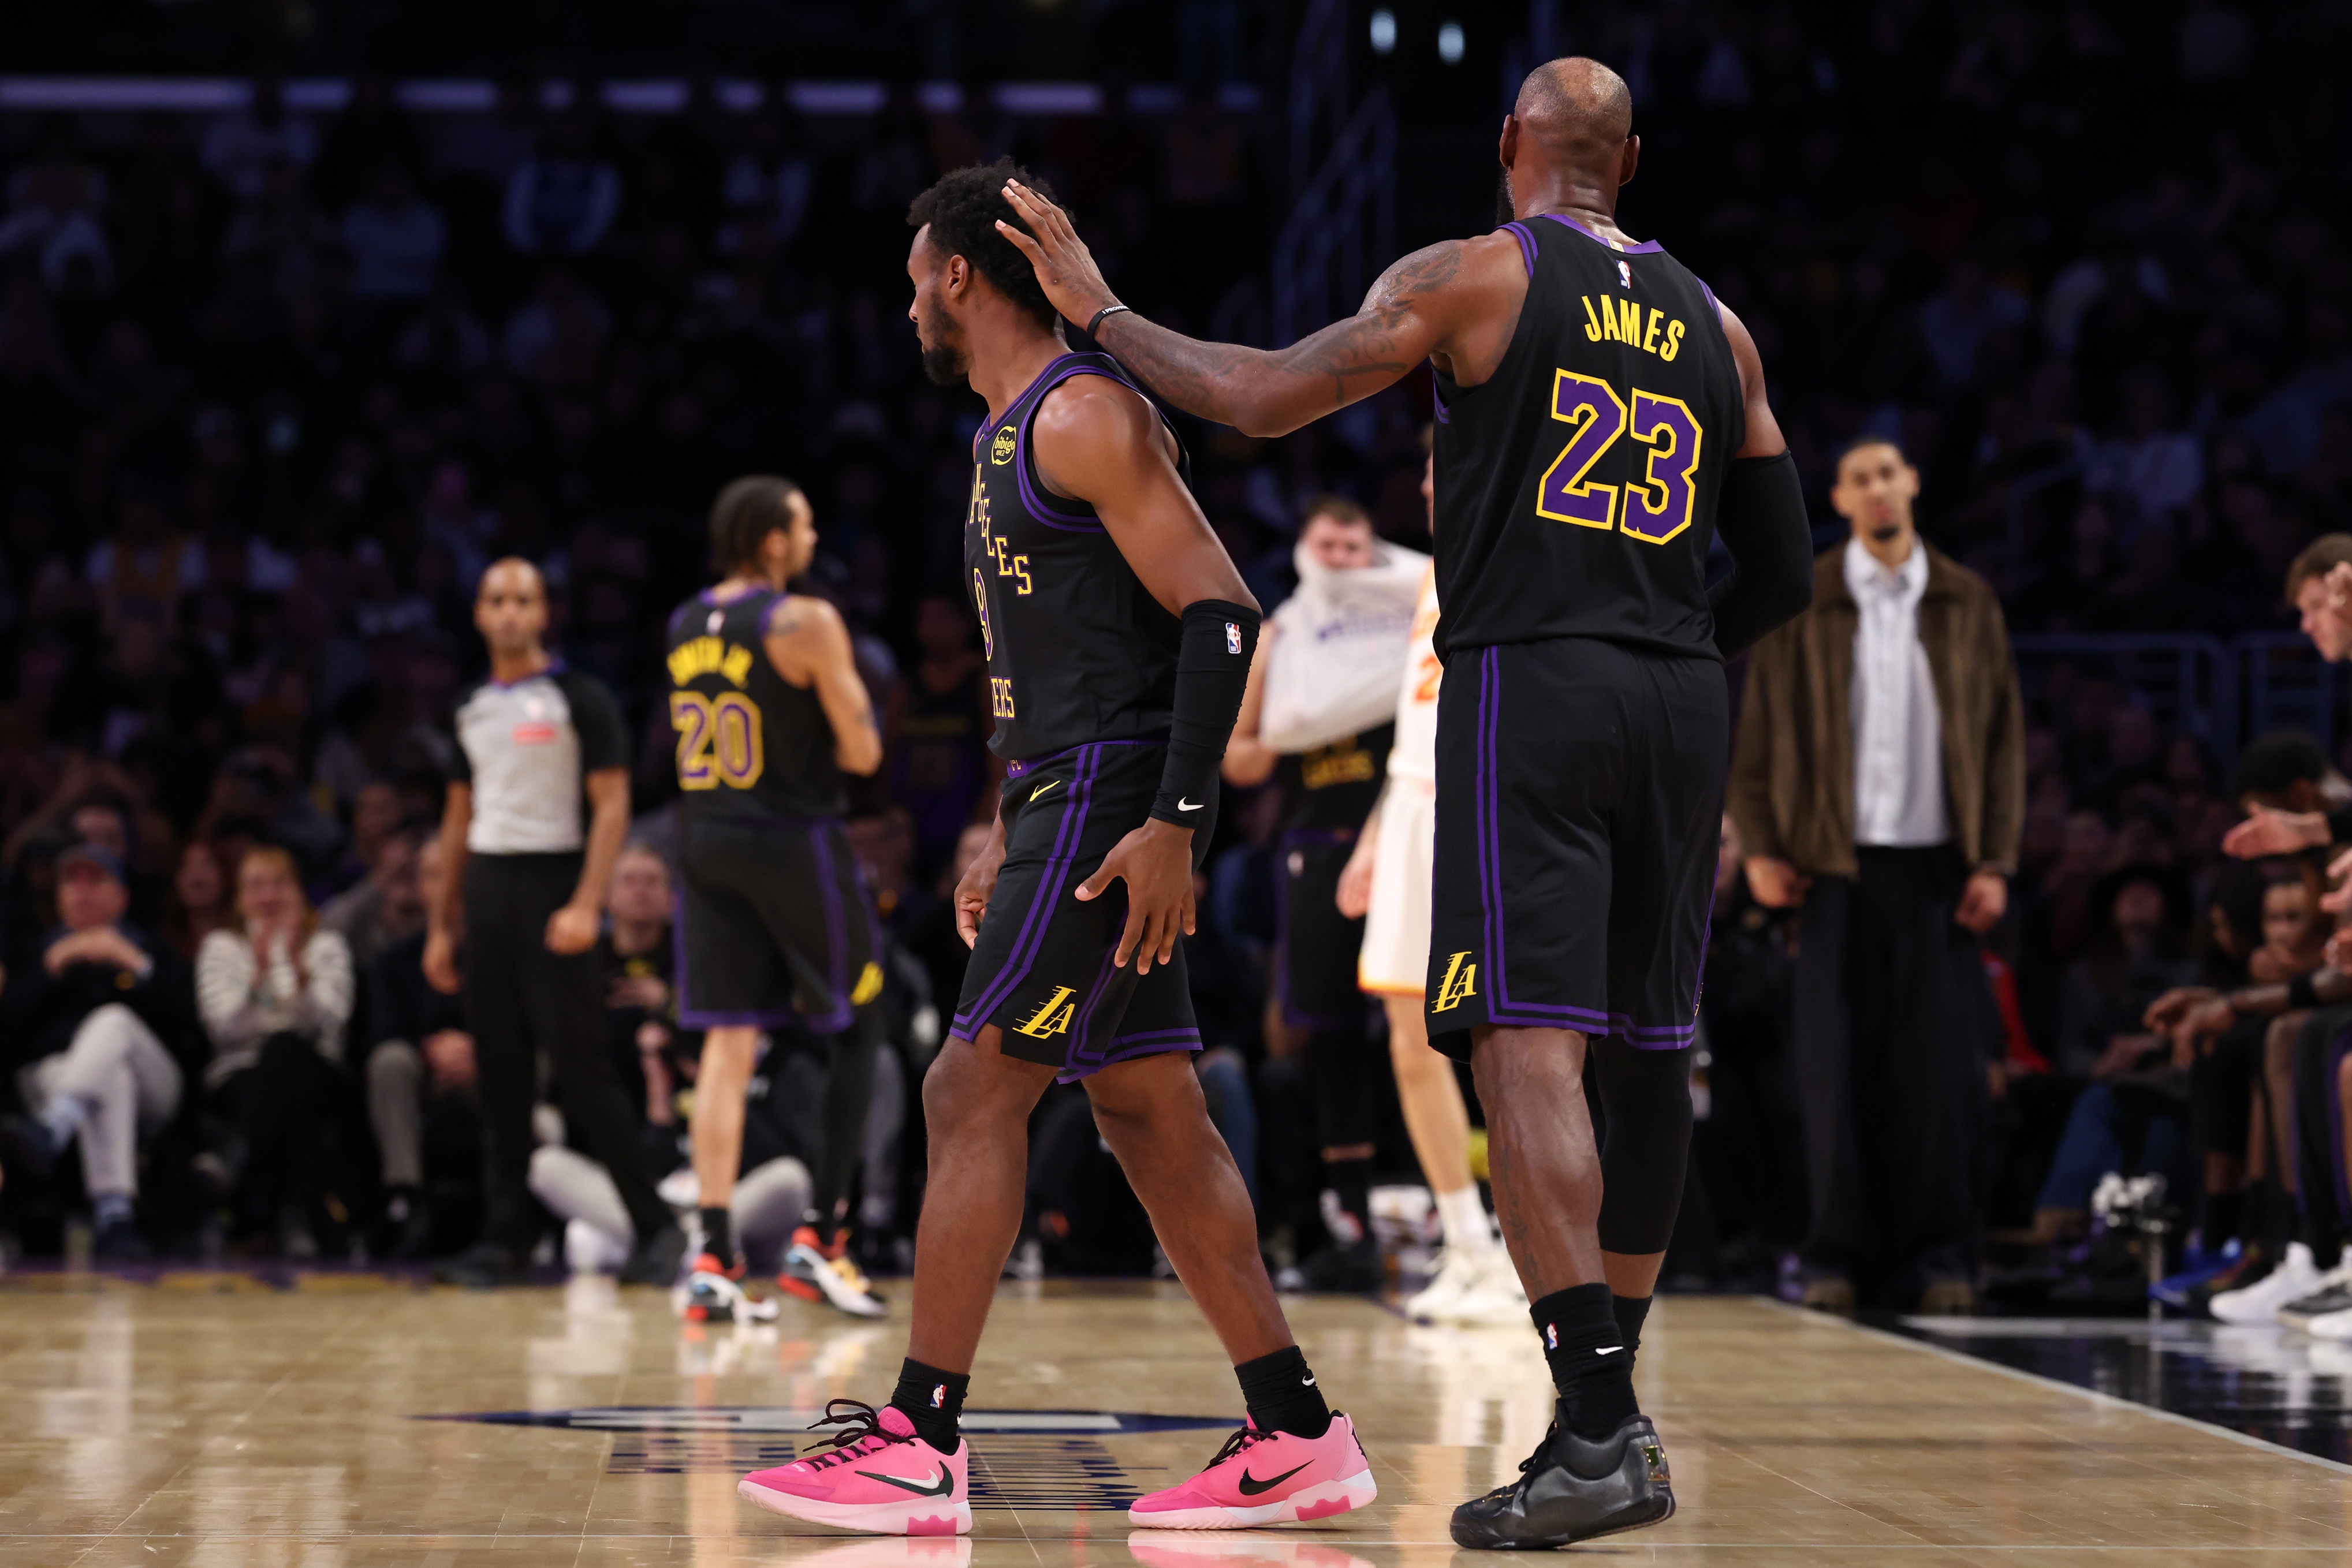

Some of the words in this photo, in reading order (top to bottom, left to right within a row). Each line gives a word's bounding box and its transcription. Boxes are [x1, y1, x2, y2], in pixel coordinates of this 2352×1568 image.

[1582, 294, 1685, 361] JAMES
[994, 436, 1016, 454] bibigo
[1537, 368, 1702, 545] 23
[669, 690, 764, 792] 20
[1012, 985, 1077, 1040] LA
[1431, 951, 1477, 1014] LA
